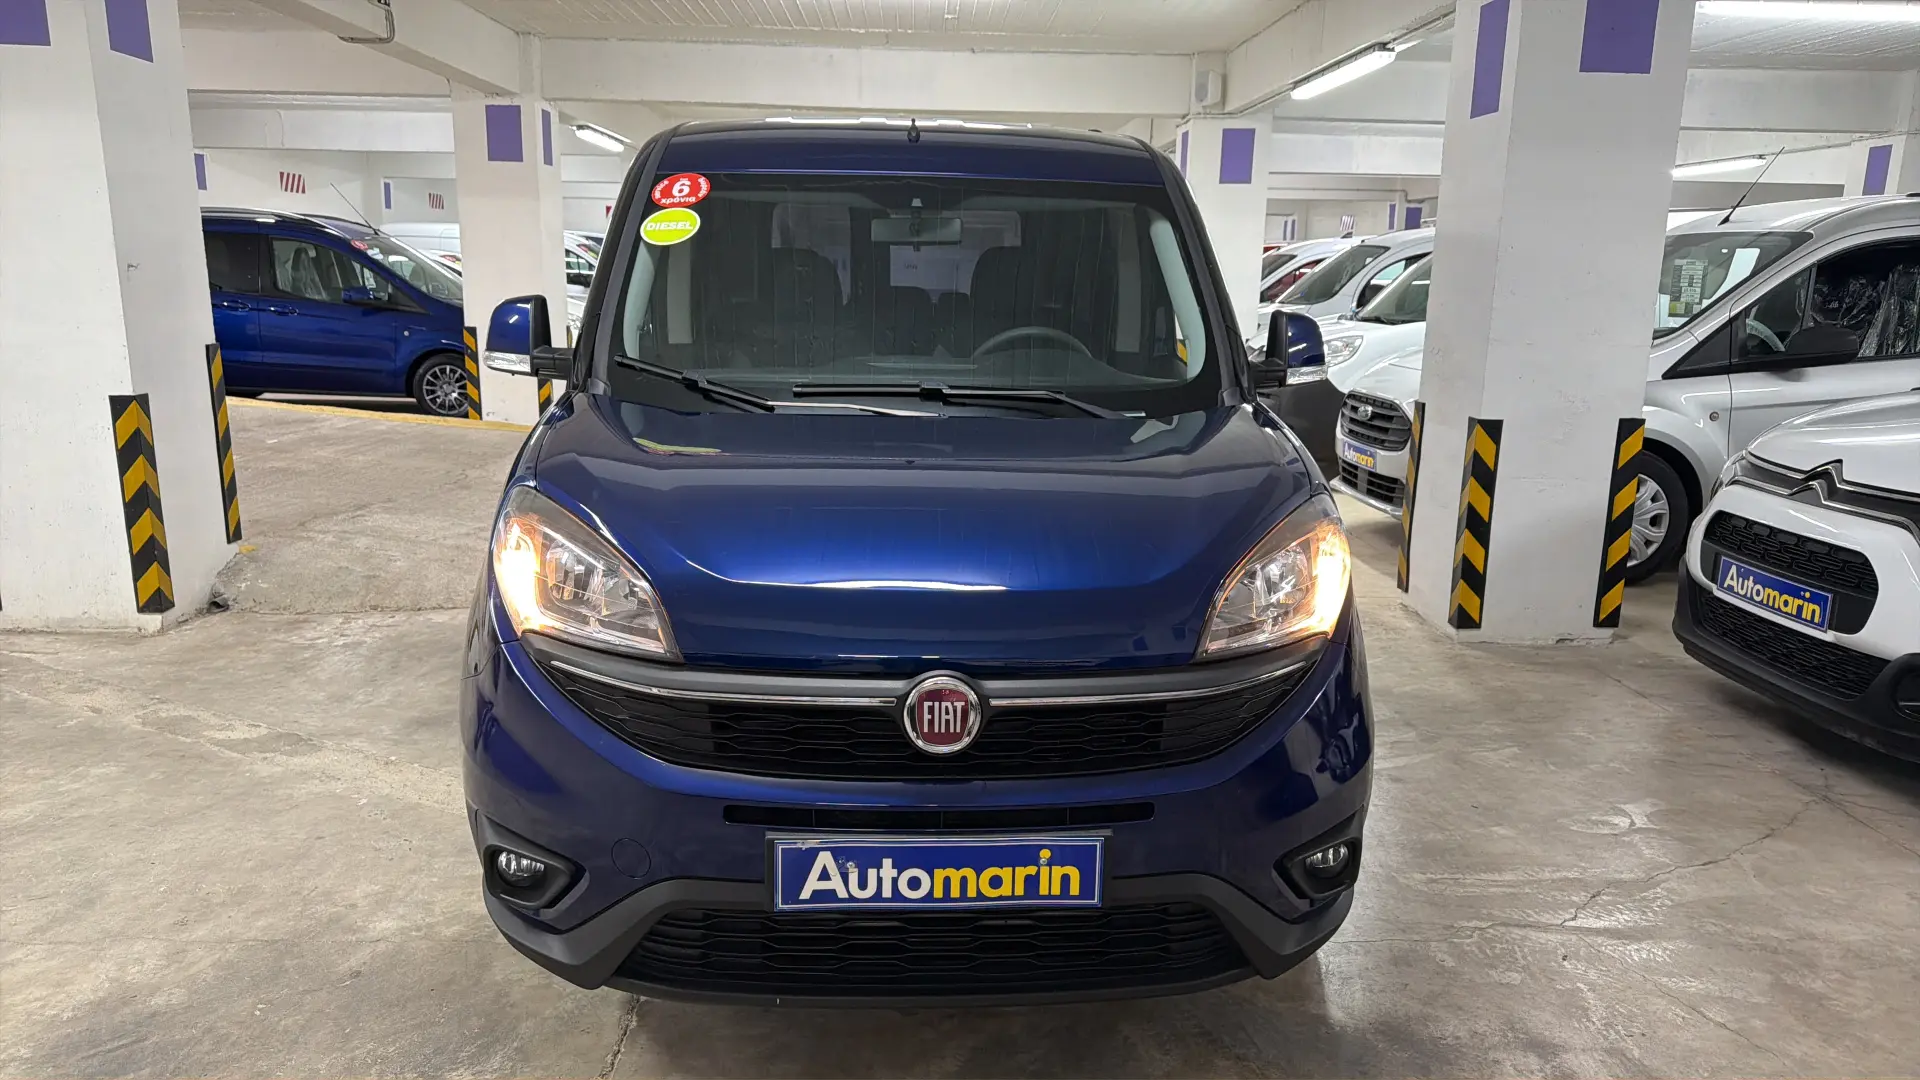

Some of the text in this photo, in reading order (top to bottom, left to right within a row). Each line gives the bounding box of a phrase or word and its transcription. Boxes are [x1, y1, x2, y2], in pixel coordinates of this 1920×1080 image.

[660, 195, 696, 205] χρόνια
[672, 180, 691, 197] 6
[646, 221, 694, 231] DIESEL
[1724, 564, 1821, 623] Automarin
[923, 701, 966, 733] FIAT
[799, 849, 1081, 900] Automarin
